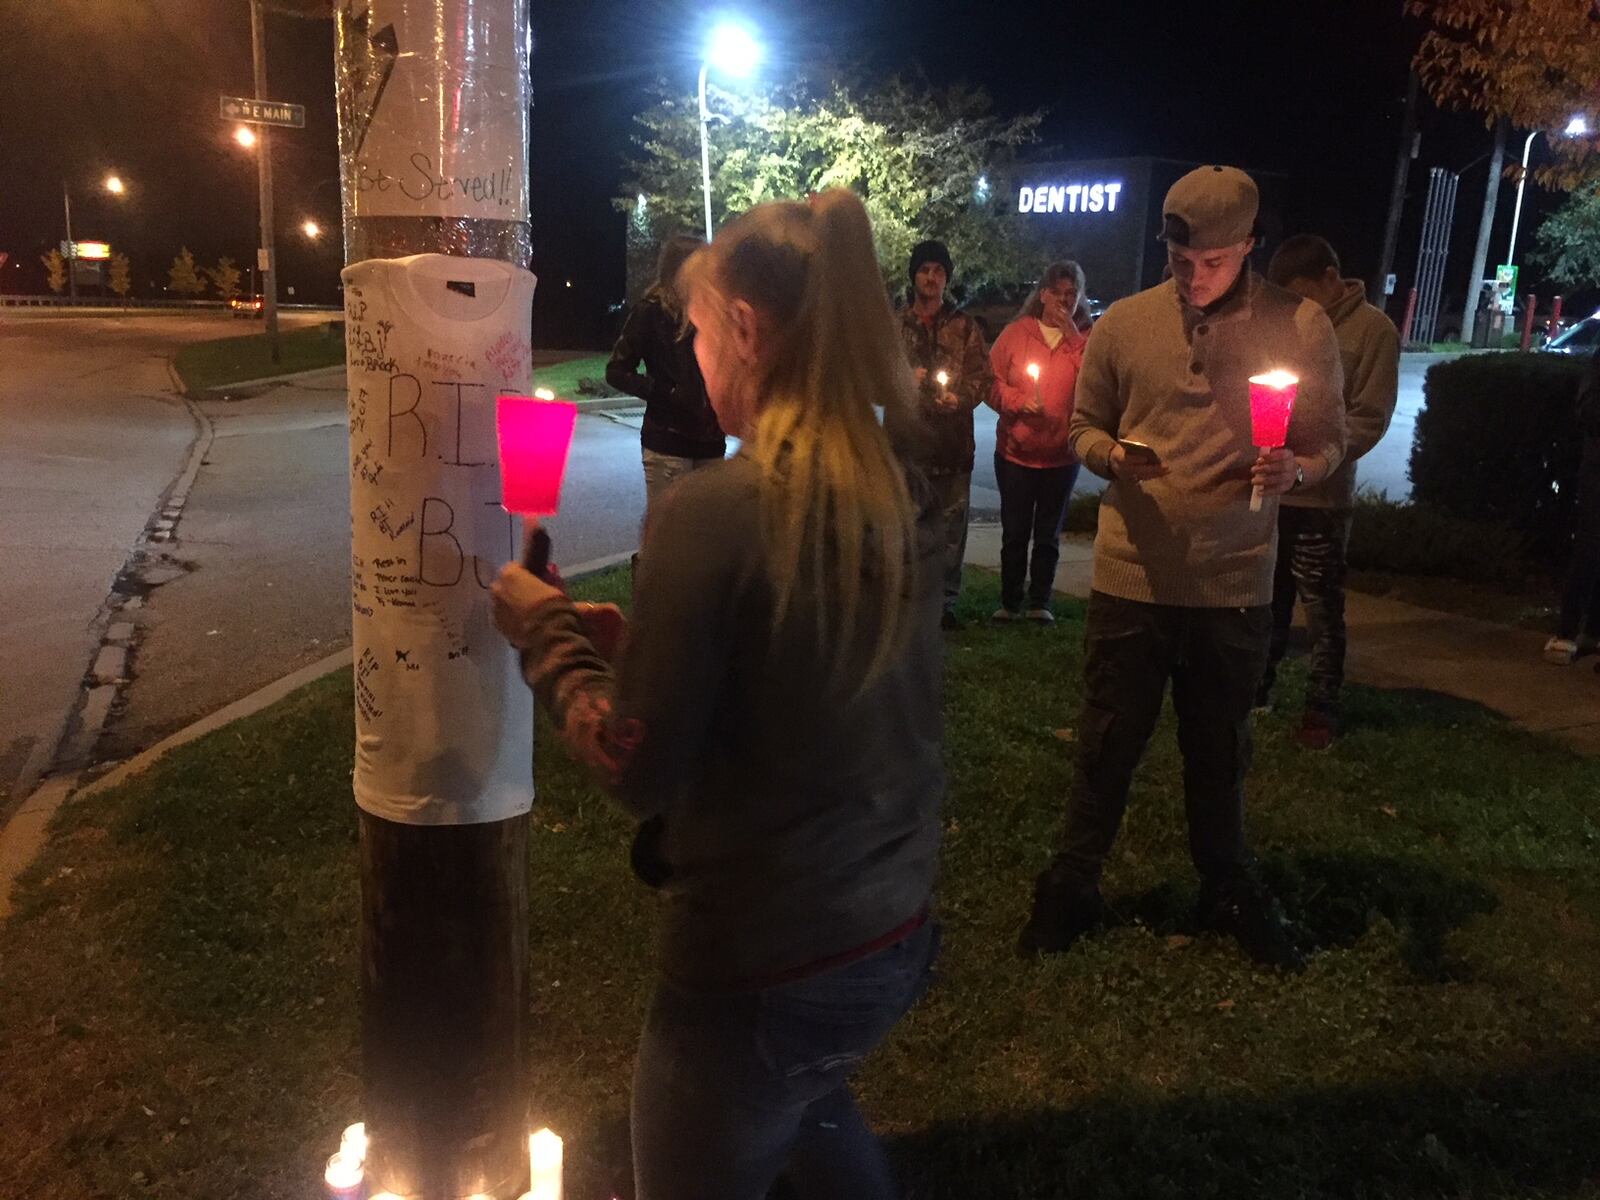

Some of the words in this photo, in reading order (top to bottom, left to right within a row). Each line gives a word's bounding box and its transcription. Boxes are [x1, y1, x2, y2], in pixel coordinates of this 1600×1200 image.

[252, 105, 260, 118] E
[263, 107, 292, 121] MAIN
[1018, 183, 1122, 213] DENTIST
